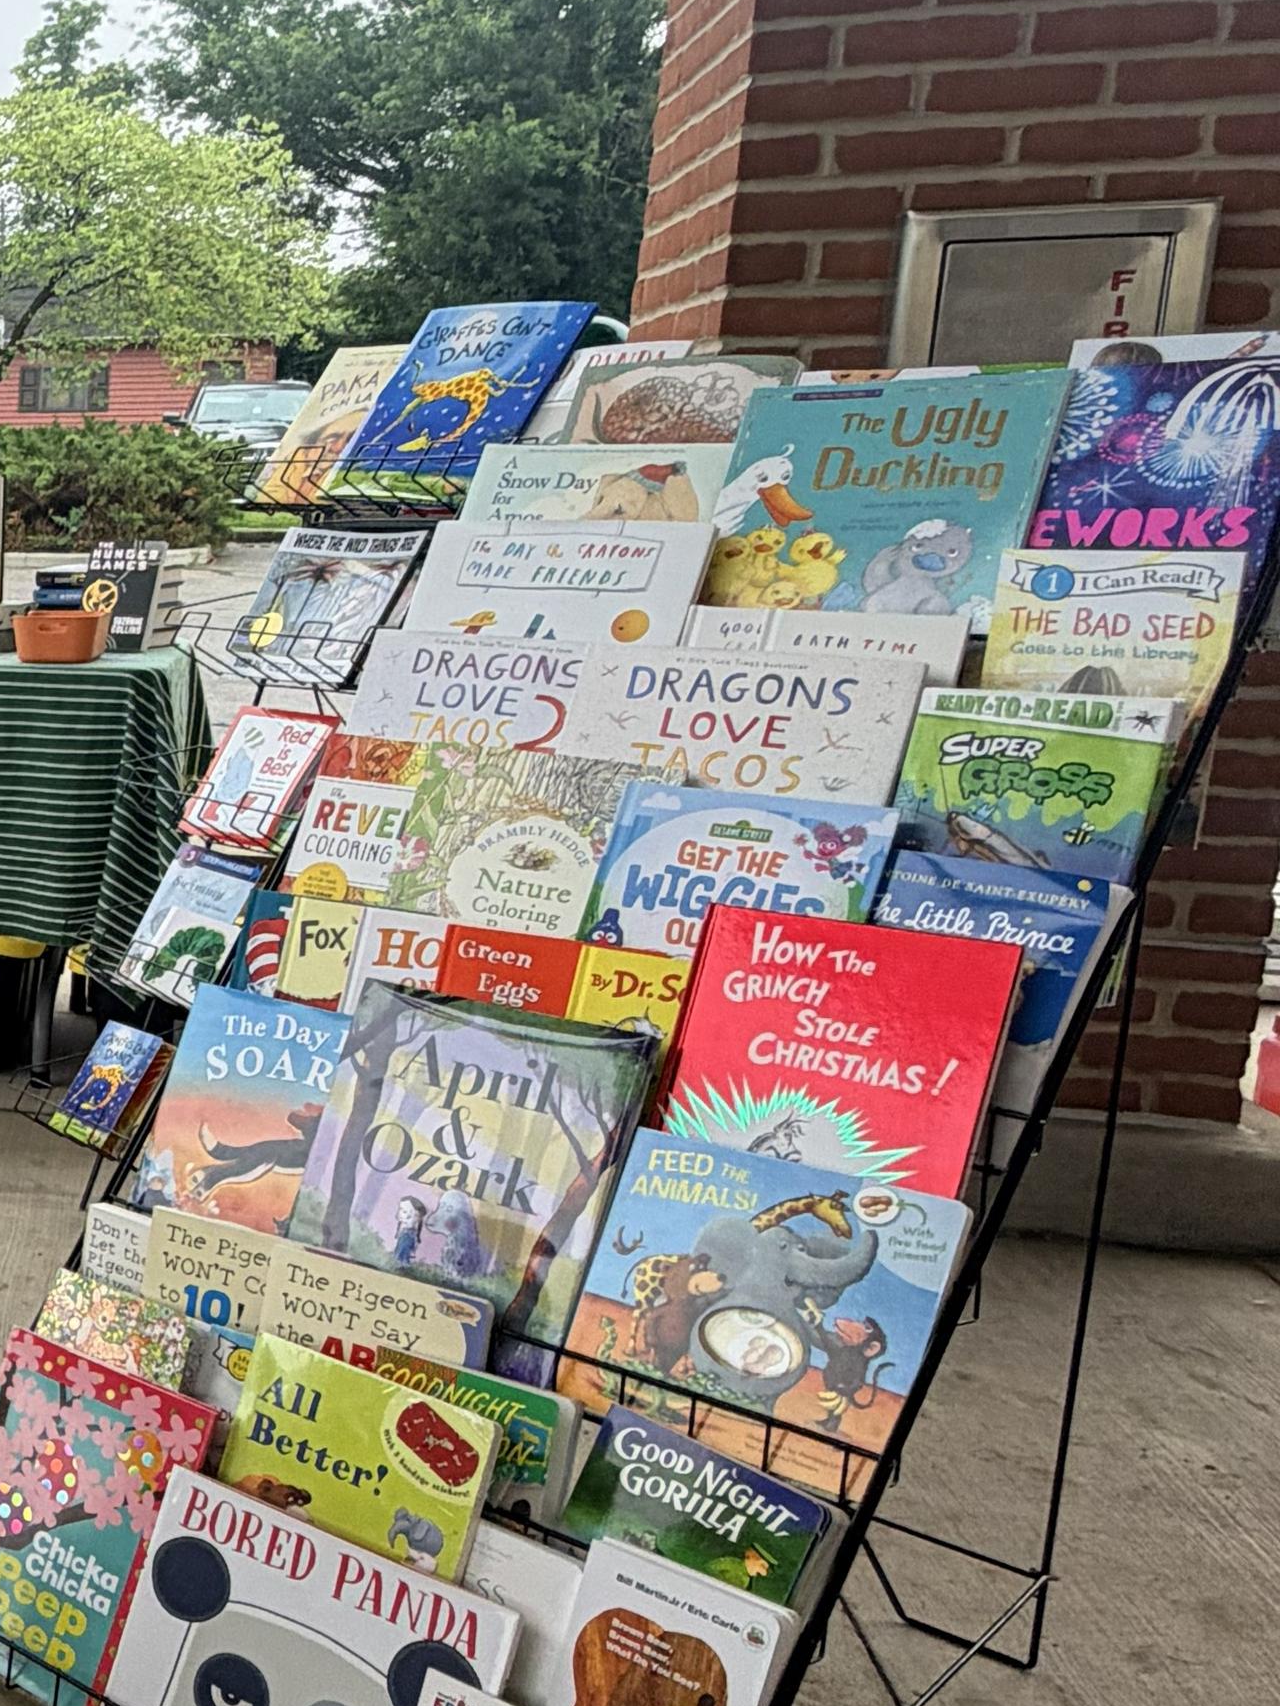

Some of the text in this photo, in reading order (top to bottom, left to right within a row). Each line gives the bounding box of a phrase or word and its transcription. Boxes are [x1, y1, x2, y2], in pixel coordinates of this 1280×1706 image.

[417, 319, 497, 350] GIRAFFES
[438, 342, 513, 367] DANCE
[842, 397, 1010, 449] The Ugly
[504, 455, 518, 469] A
[812, 446, 1005, 501] Duckling
[491, 492, 514, 505] for
[497, 472, 598, 493] Snow Day
[92, 549, 160, 560] HUNGER
[293, 533, 420, 554] WHERE THE THINGS ARE
[502, 542, 536, 559] DAY
[90, 560, 148, 571] GAMES
[466, 561, 628, 586] MADE FRIENDS
[1080, 570, 1203, 591] I Can Read!
[1010, 606, 1215, 642] THE BAD SEED
[412, 648, 583, 688] DRAGONS
[1063, 644, 1199, 663] to the Library
[415, 682, 524, 717] LOVE
[625, 666, 859, 716] DRAGONS
[409, 694, 567, 756] TACOS 2
[658, 707, 792, 749] LOVE
[1032, 698, 1114, 729] READ
[277, 725, 316, 745] Red
[277, 744, 291, 760] is
[939, 731, 1045, 765] SUPER
[260, 757, 298, 777] Best
[630, 742, 803, 794] TACOS
[960, 757, 1115, 809] GROSS
[304, 834, 393, 864] COLORING
[477, 826, 590, 868] BRAMBLY HEDGE
[677, 840, 789, 878] GET THE
[474, 867, 572, 904] Nature
[472, 896, 561, 930] Coloring
[904, 901, 1074, 954] Little Prince
[457, 939, 533, 970] Green
[476, 972, 541, 1009] Eggs
[590, 970, 654, 1001] By Dr.
[722, 971, 830, 1008] GRINCH
[222, 1014, 332, 1054] The Day
[793, 1008, 881, 1047] STOLE
[394, 1034, 561, 1115] April
[432, 1105, 483, 1161] &
[361, 1121, 539, 1217] Ozark
[646, 1148, 752, 1186] FEED THE
[629, 1174, 759, 1212] ANIMALS!
[90, 1234, 115, 1255] Let
[92, 1217, 140, 1246] Don't
[165, 1223, 207, 1249] The
[87, 1251, 144, 1283] Pigeon
[162, 1251, 236, 1286] WON'T
[159, 1284, 181, 1305] to
[286, 1263, 331, 1291] The
[341, 1279, 428, 1320] Pigeon
[276, 1322, 315, 1346] the
[281, 1293, 423, 1353] WON'T Say
[258, 1375, 323, 1423] All
[246, 1411, 389, 1497] Better!
[613, 1426, 695, 1476] GOOD
[618, 1462, 748, 1544] GORILLA
[32, 1530, 120, 1592] Chicka
[179, 1486, 480, 1661] BORED PANDA
[24, 1552, 112, 1617] Chicka
[711, 1615, 740, 1633] Carle
